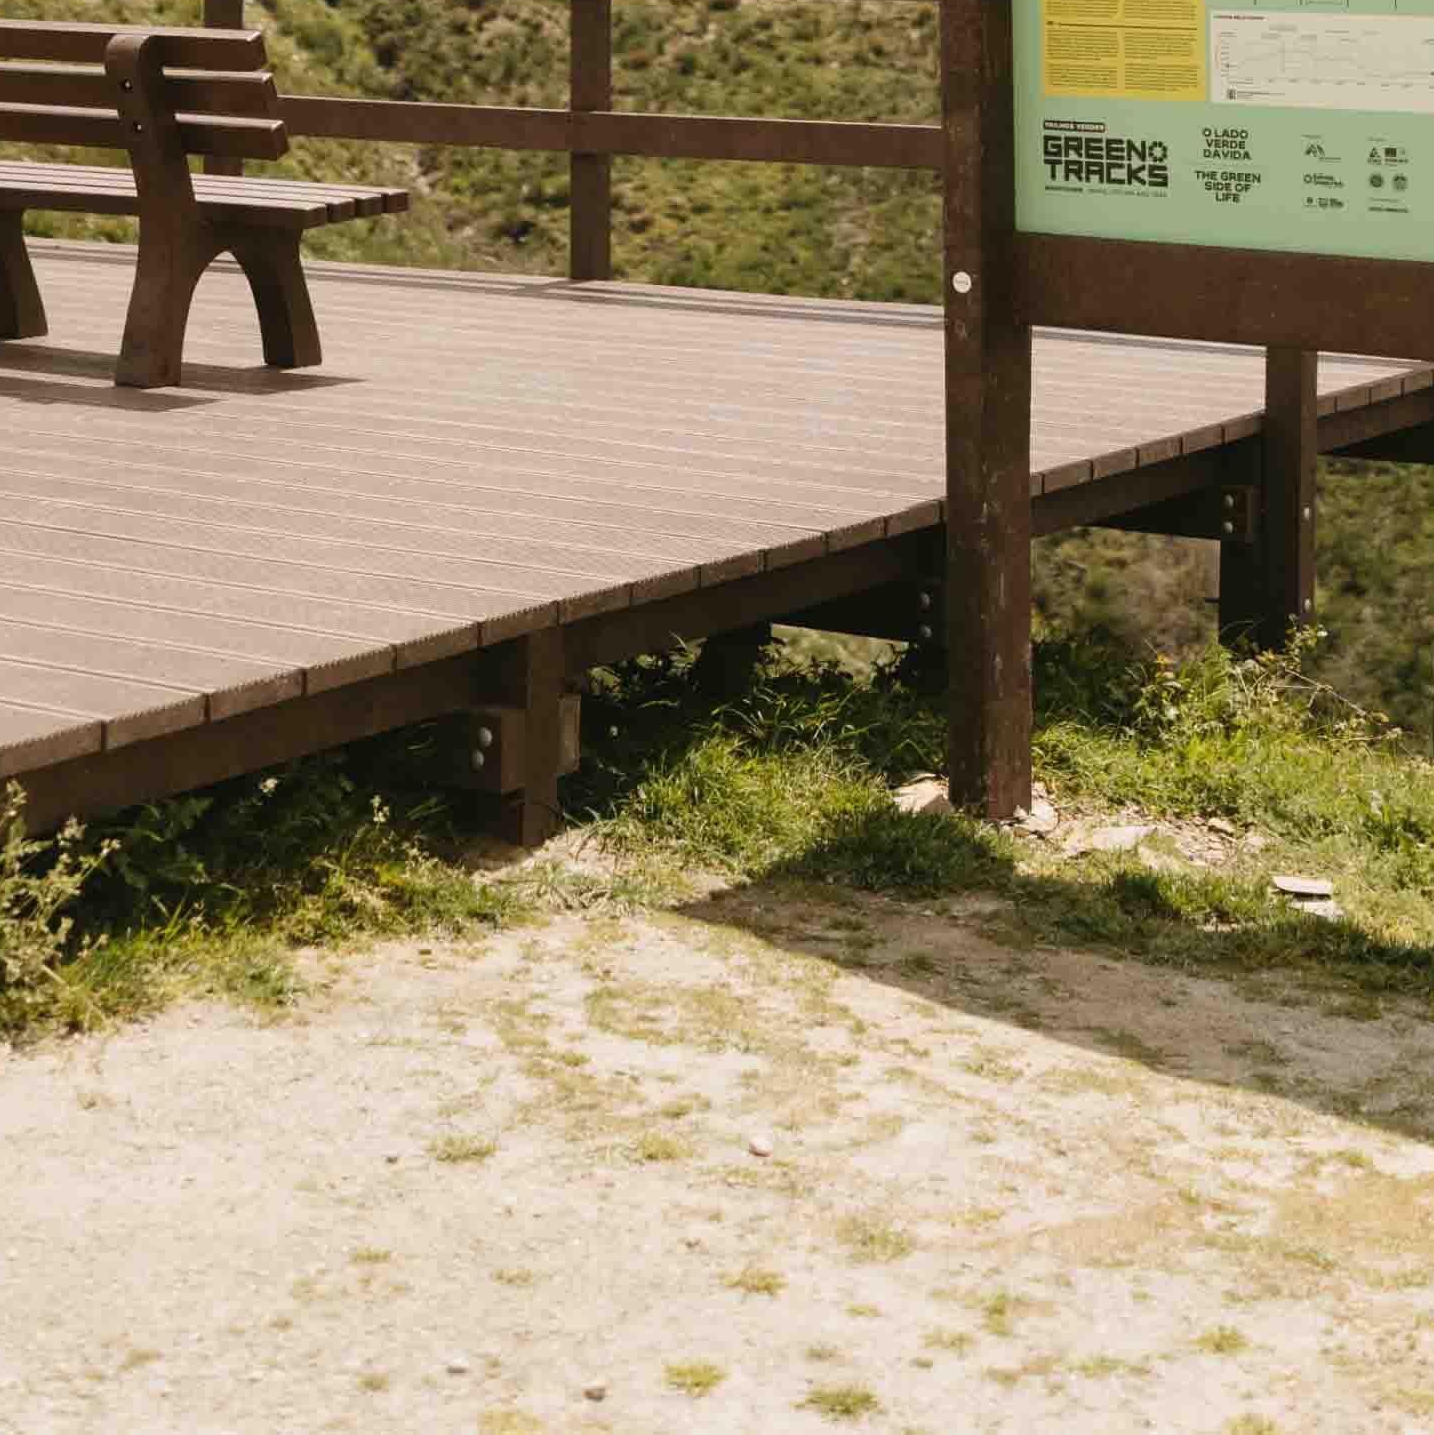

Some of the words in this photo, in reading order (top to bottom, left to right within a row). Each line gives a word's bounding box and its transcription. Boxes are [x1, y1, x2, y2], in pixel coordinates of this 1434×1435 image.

[1203, 128, 1212, 137] O
[1214, 128, 1249, 140] LADO
[1044, 134, 1146, 162] GREEN
[1206, 138, 1246, 150] VERDE
[1044, 158, 1168, 187] TRACKS
[1194, 170, 1218, 181] THE
[1221, 171, 1261, 183] GREEN
[1205, 181, 1233, 191] SIDE
[1235, 183, 1252, 193] OF
[1215, 192, 1240, 203] LIFE
